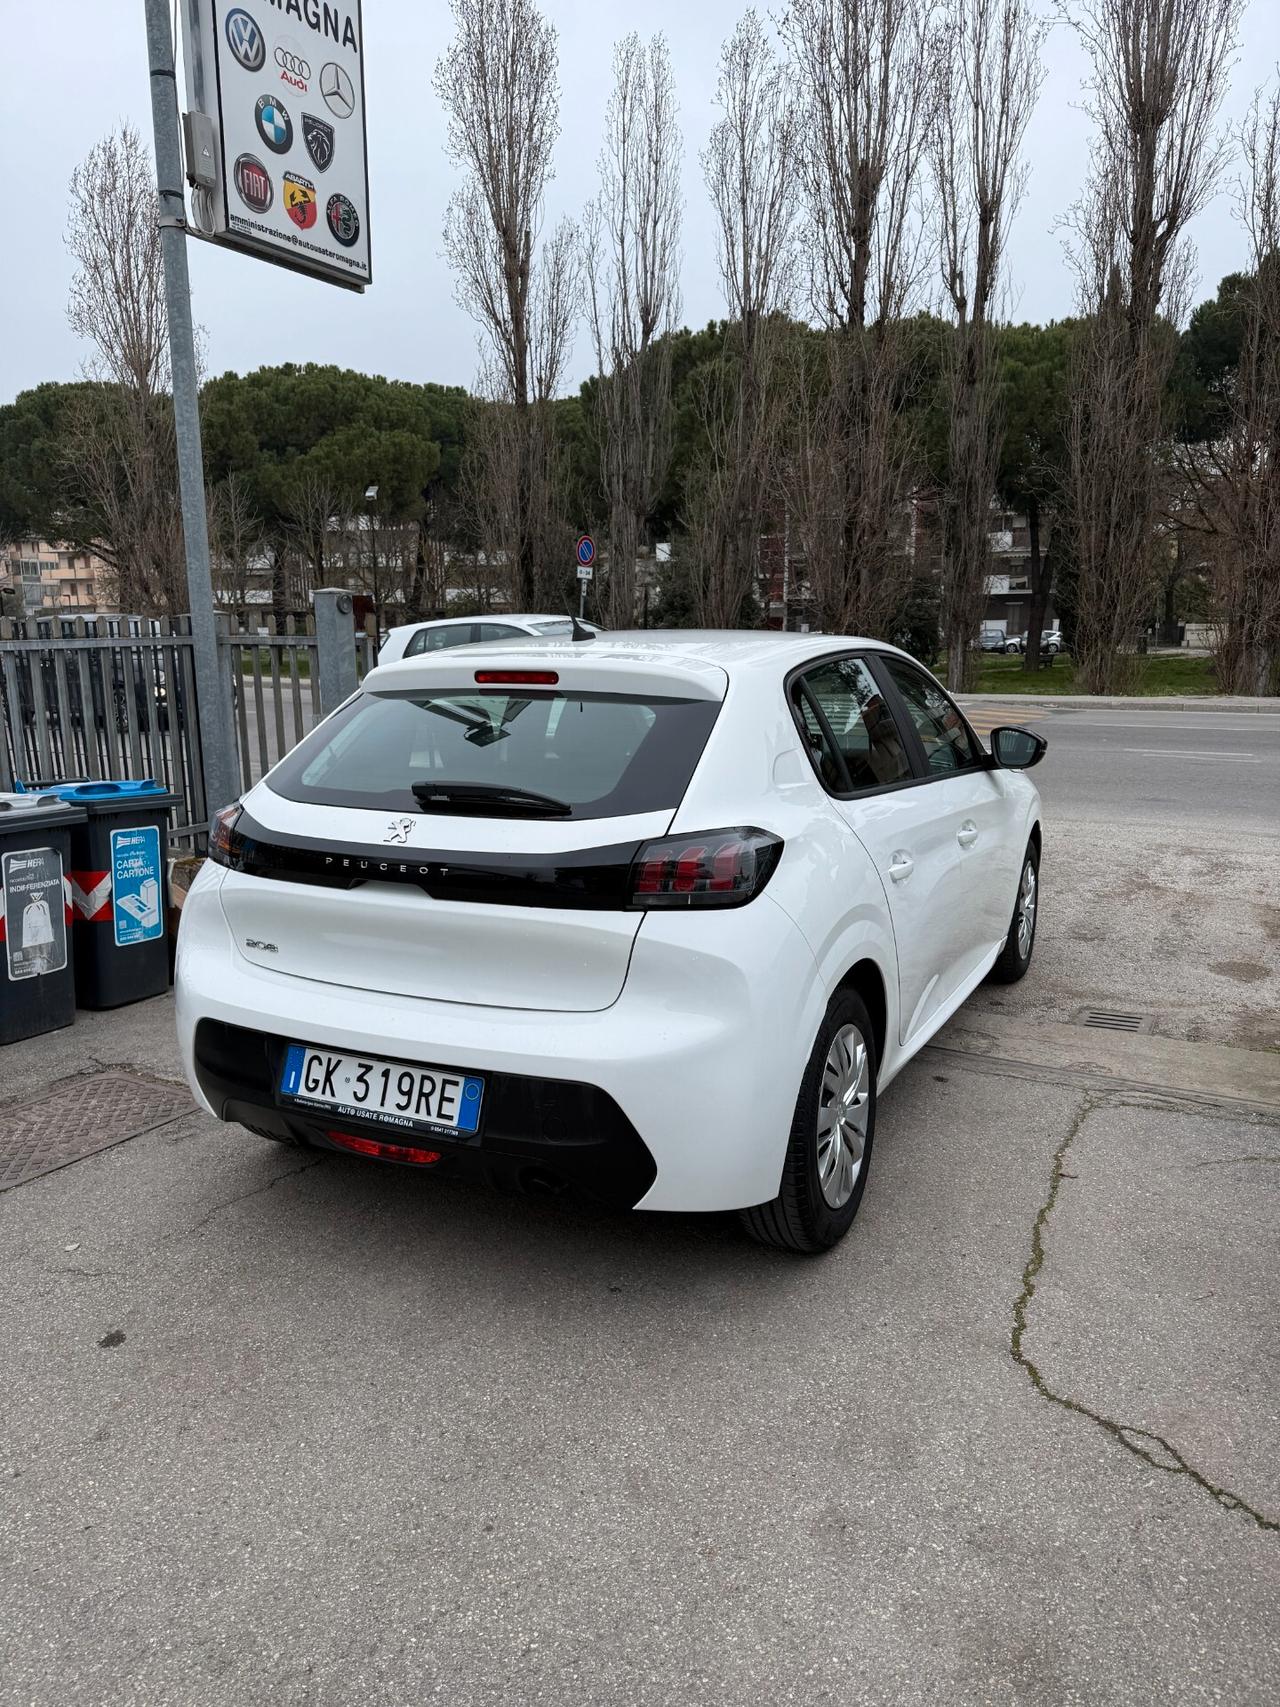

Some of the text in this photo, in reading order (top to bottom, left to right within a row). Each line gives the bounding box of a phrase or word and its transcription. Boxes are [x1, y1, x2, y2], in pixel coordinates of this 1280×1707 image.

[257, 96, 290, 121] BMW
[243, 169, 266, 200] FIAT
[284, 173, 315, 190] ABARTH
[230, 213, 368, 271] amministrazione@autousateromagna.it
[116, 857, 144, 870] CARTA
[116, 866, 155, 880] CARTONE
[325, 857, 449, 876] PEUGEOT
[9, 878, 60, 893] INDIFFERENZIATA
[304, 1055, 460, 1121] GK 319RE
[337, 1106, 414, 1128] AUTO USATE ROMAGNA
